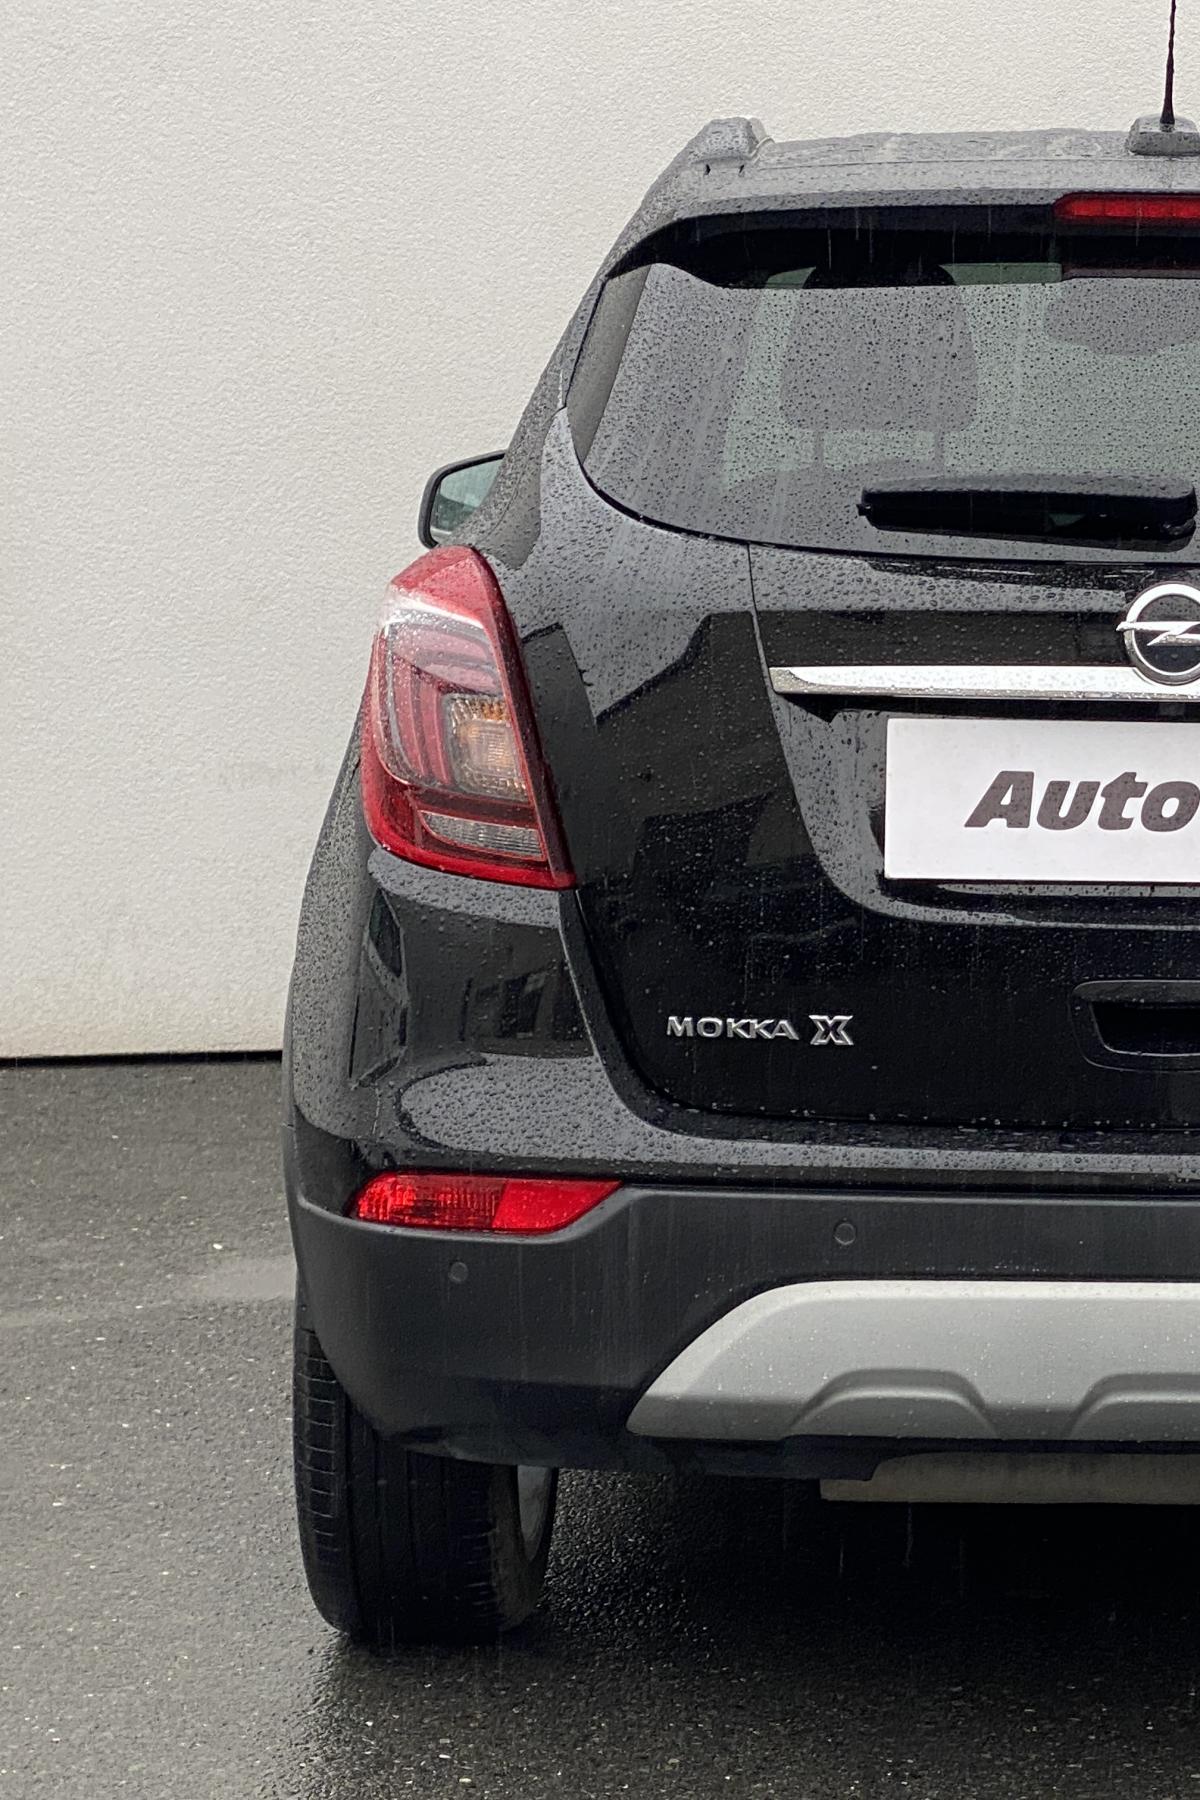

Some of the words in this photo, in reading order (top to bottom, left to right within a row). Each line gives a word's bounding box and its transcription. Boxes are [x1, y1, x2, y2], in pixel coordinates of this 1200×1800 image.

[964, 770, 1200, 832] Auto
[666, 1015, 800, 1040] MOKKA
[808, 1014, 854, 1046] X
